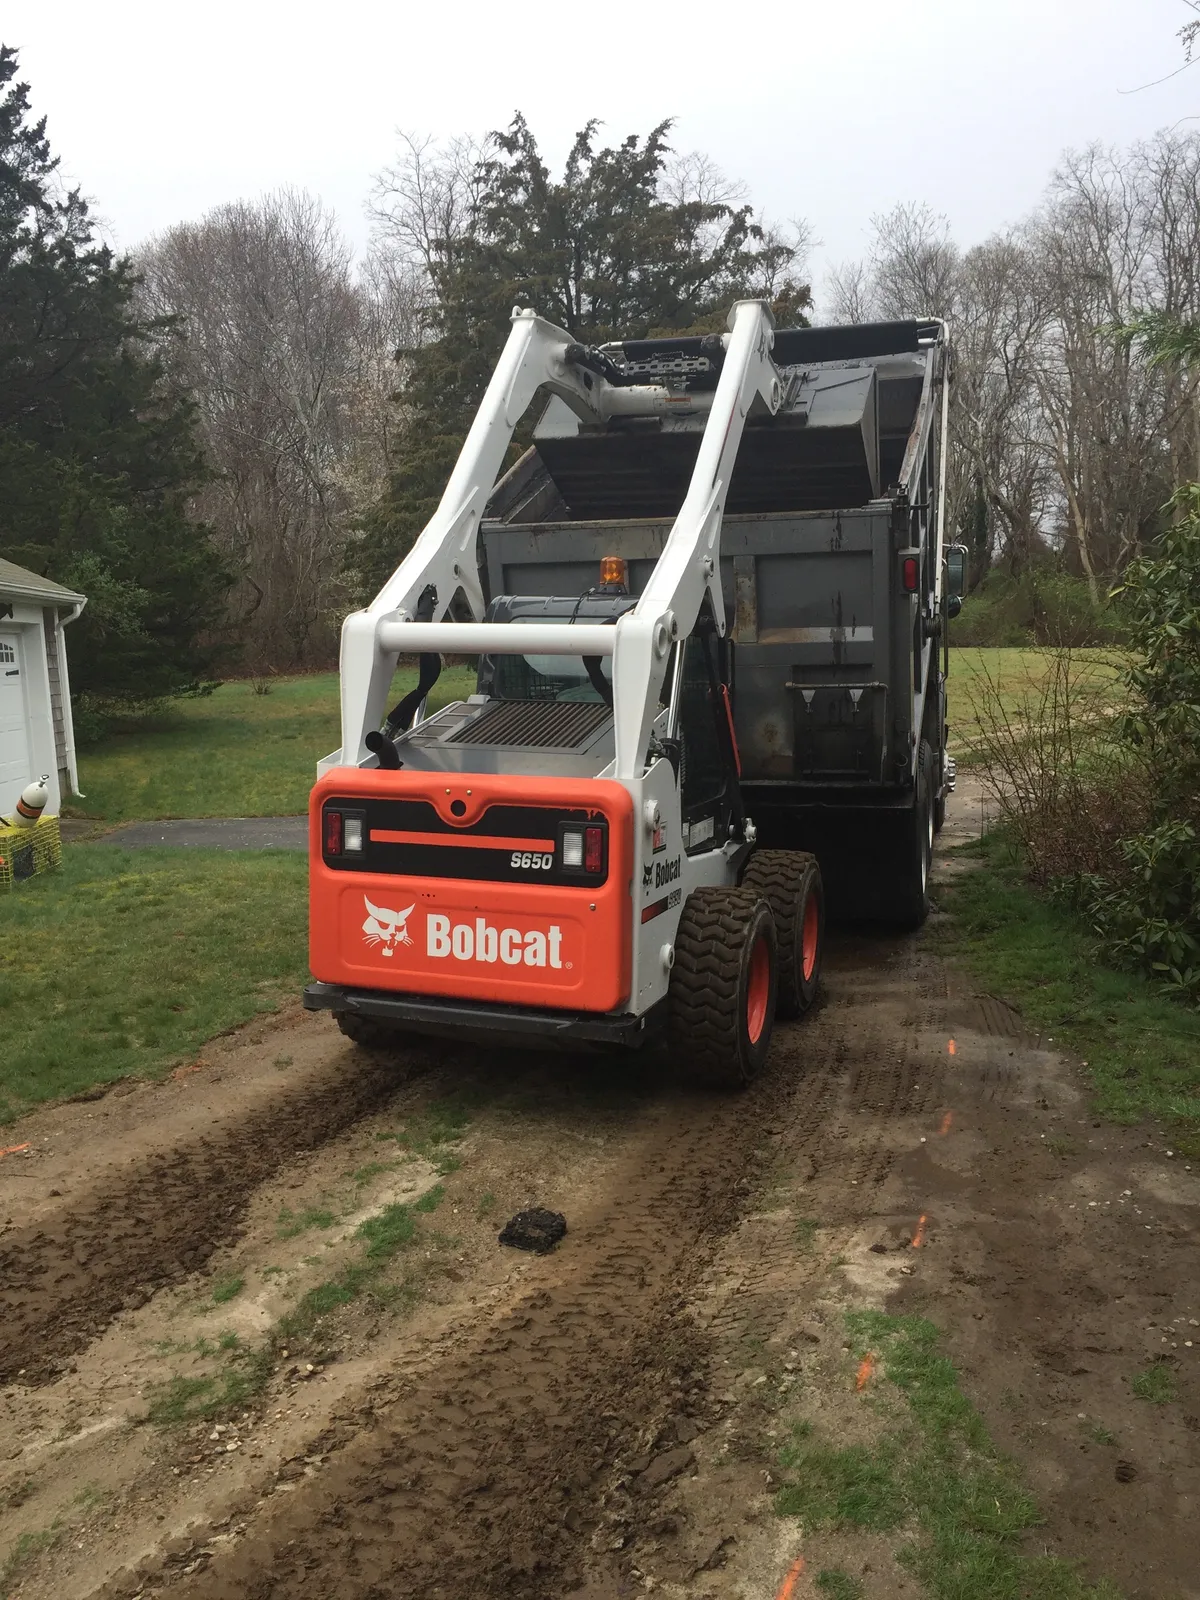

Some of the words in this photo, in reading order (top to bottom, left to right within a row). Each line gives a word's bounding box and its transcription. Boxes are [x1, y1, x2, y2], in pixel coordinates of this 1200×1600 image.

[510, 852, 553, 870] S650
[655, 854, 681, 889] Bobcat
[426, 914, 563, 969] Bobcat
